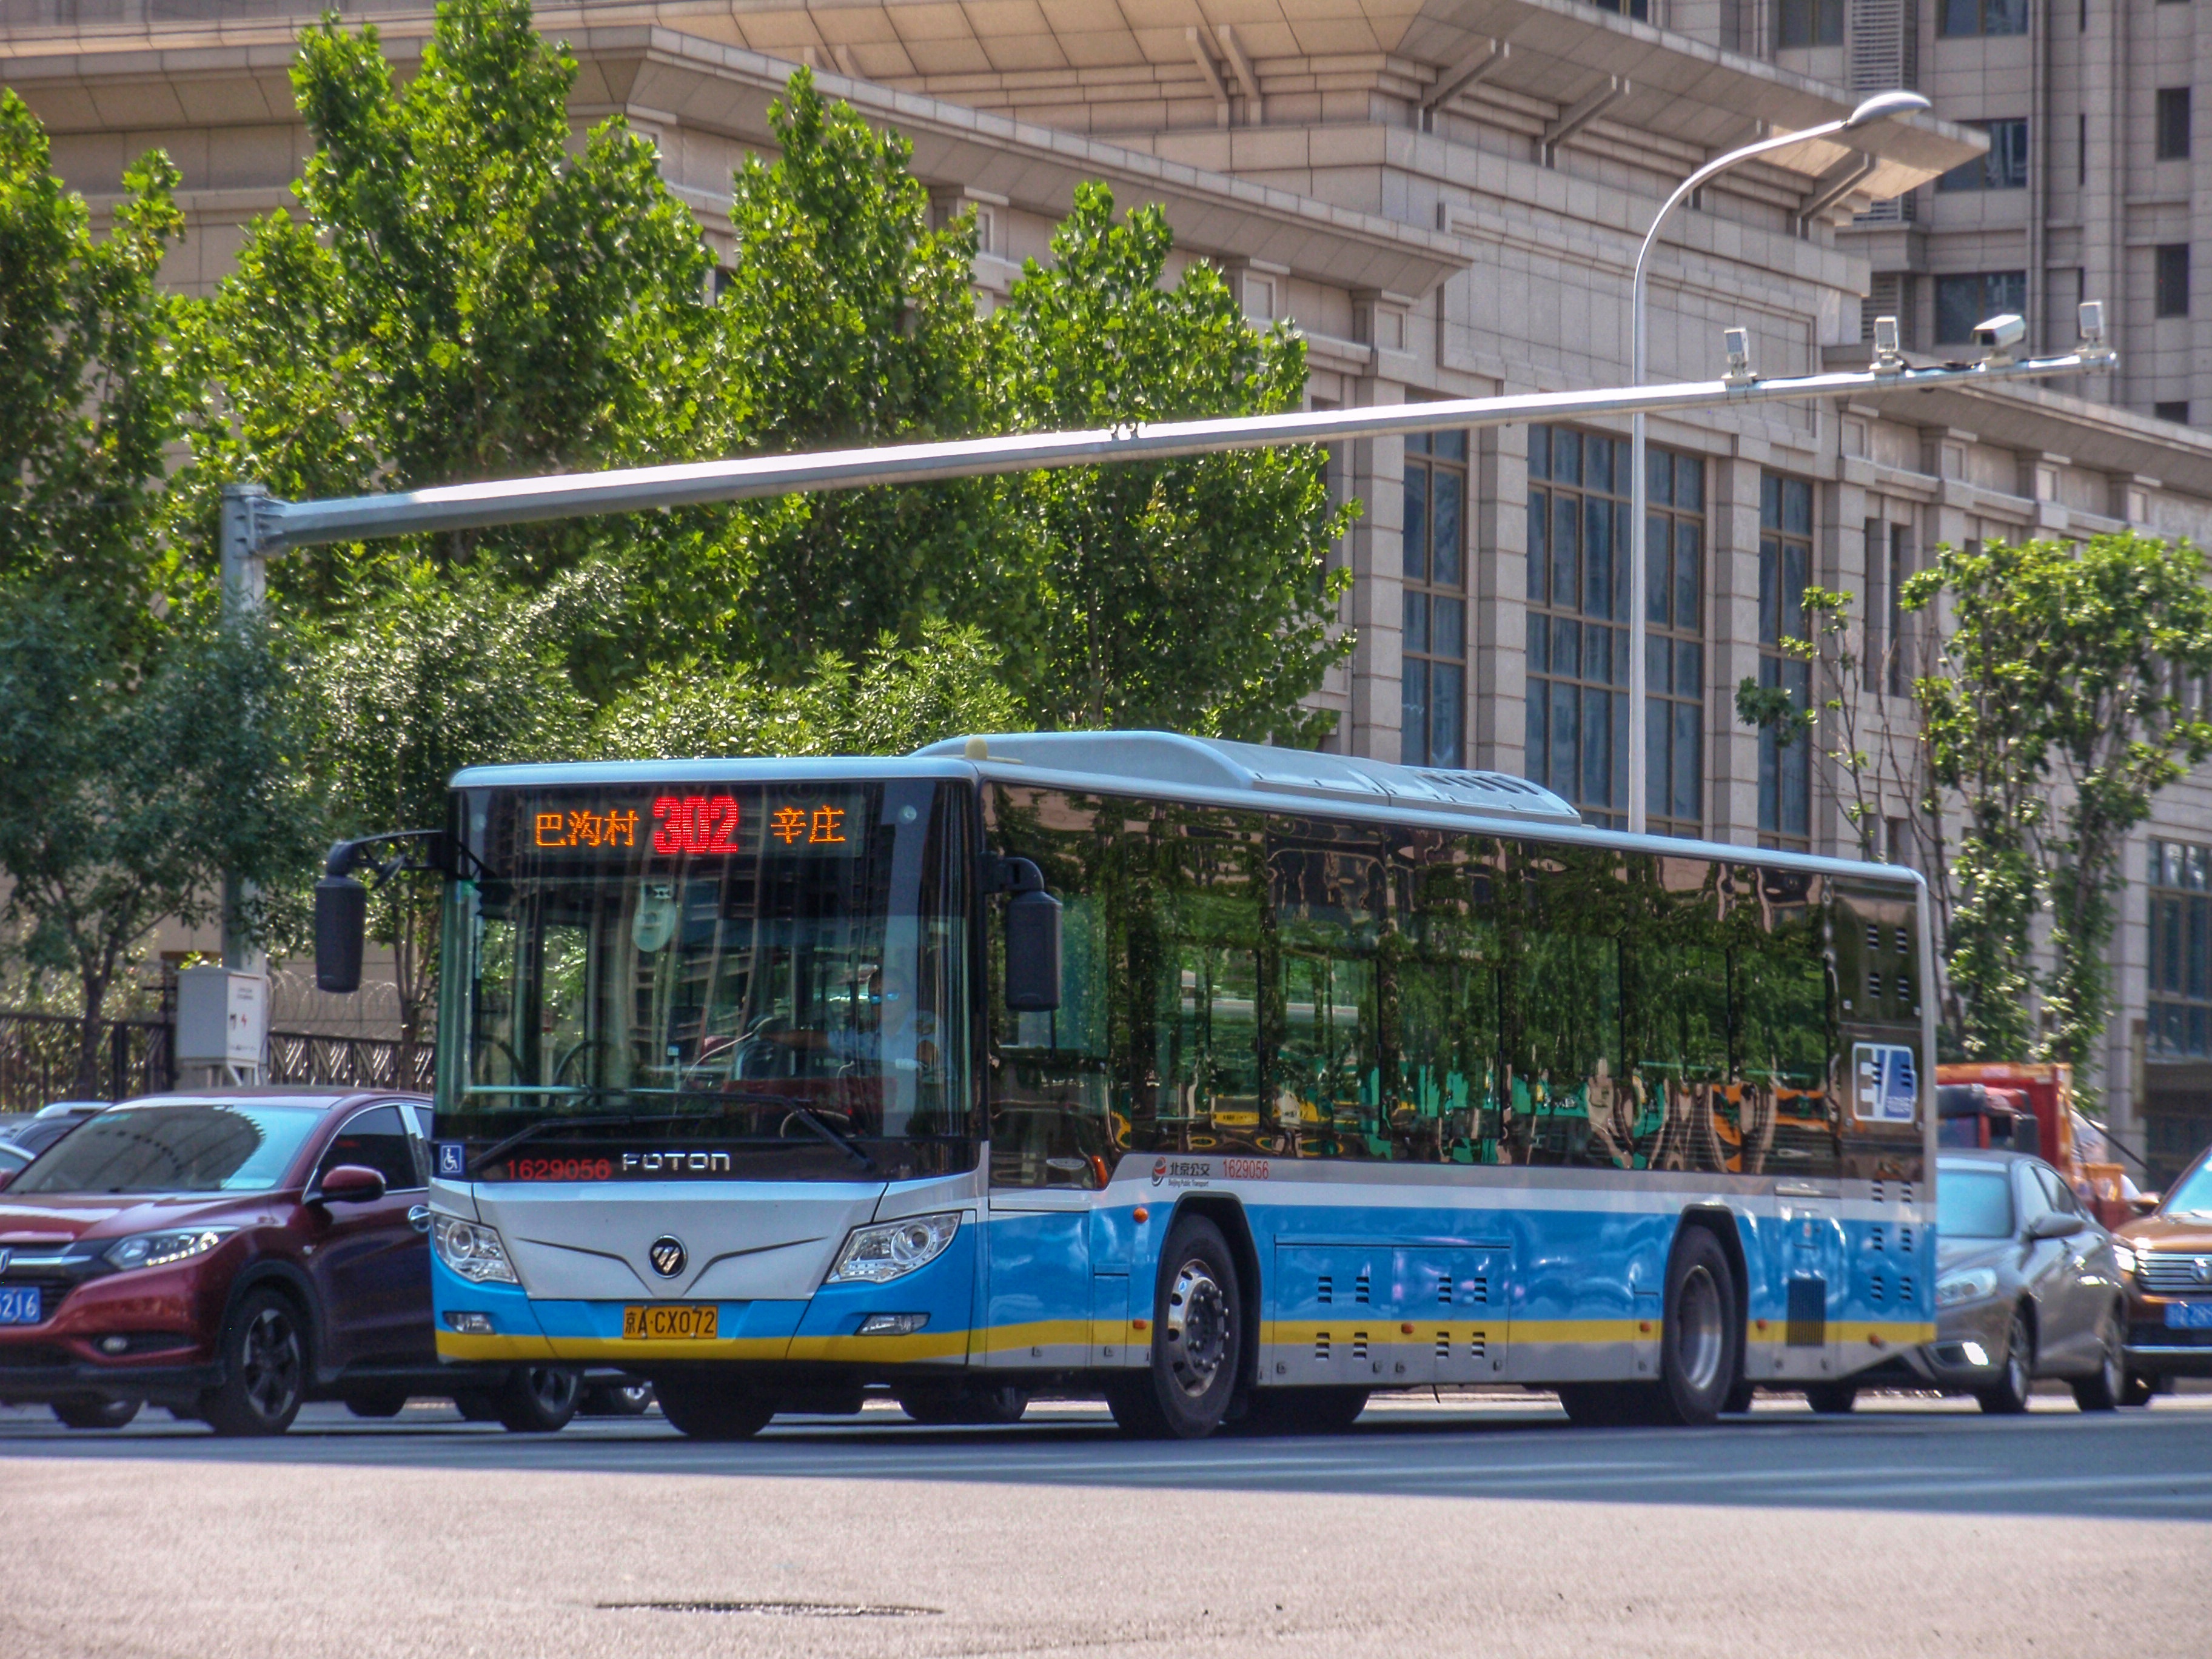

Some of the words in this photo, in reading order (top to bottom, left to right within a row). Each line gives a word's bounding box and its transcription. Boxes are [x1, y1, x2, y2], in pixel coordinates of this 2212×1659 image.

[535, 810, 638, 846] 巴沟村
[653, 796, 739, 854] 302
[770, 805, 846, 844] 辛庄
[507, 1159, 612, 1180] 1629056
[622, 1153, 731, 1171] FOTON
[1168, 1162, 1210, 1176] 北京公交
[1222, 1158, 1270, 1179] 1629056
[0, 1293, 37, 1318] 216
